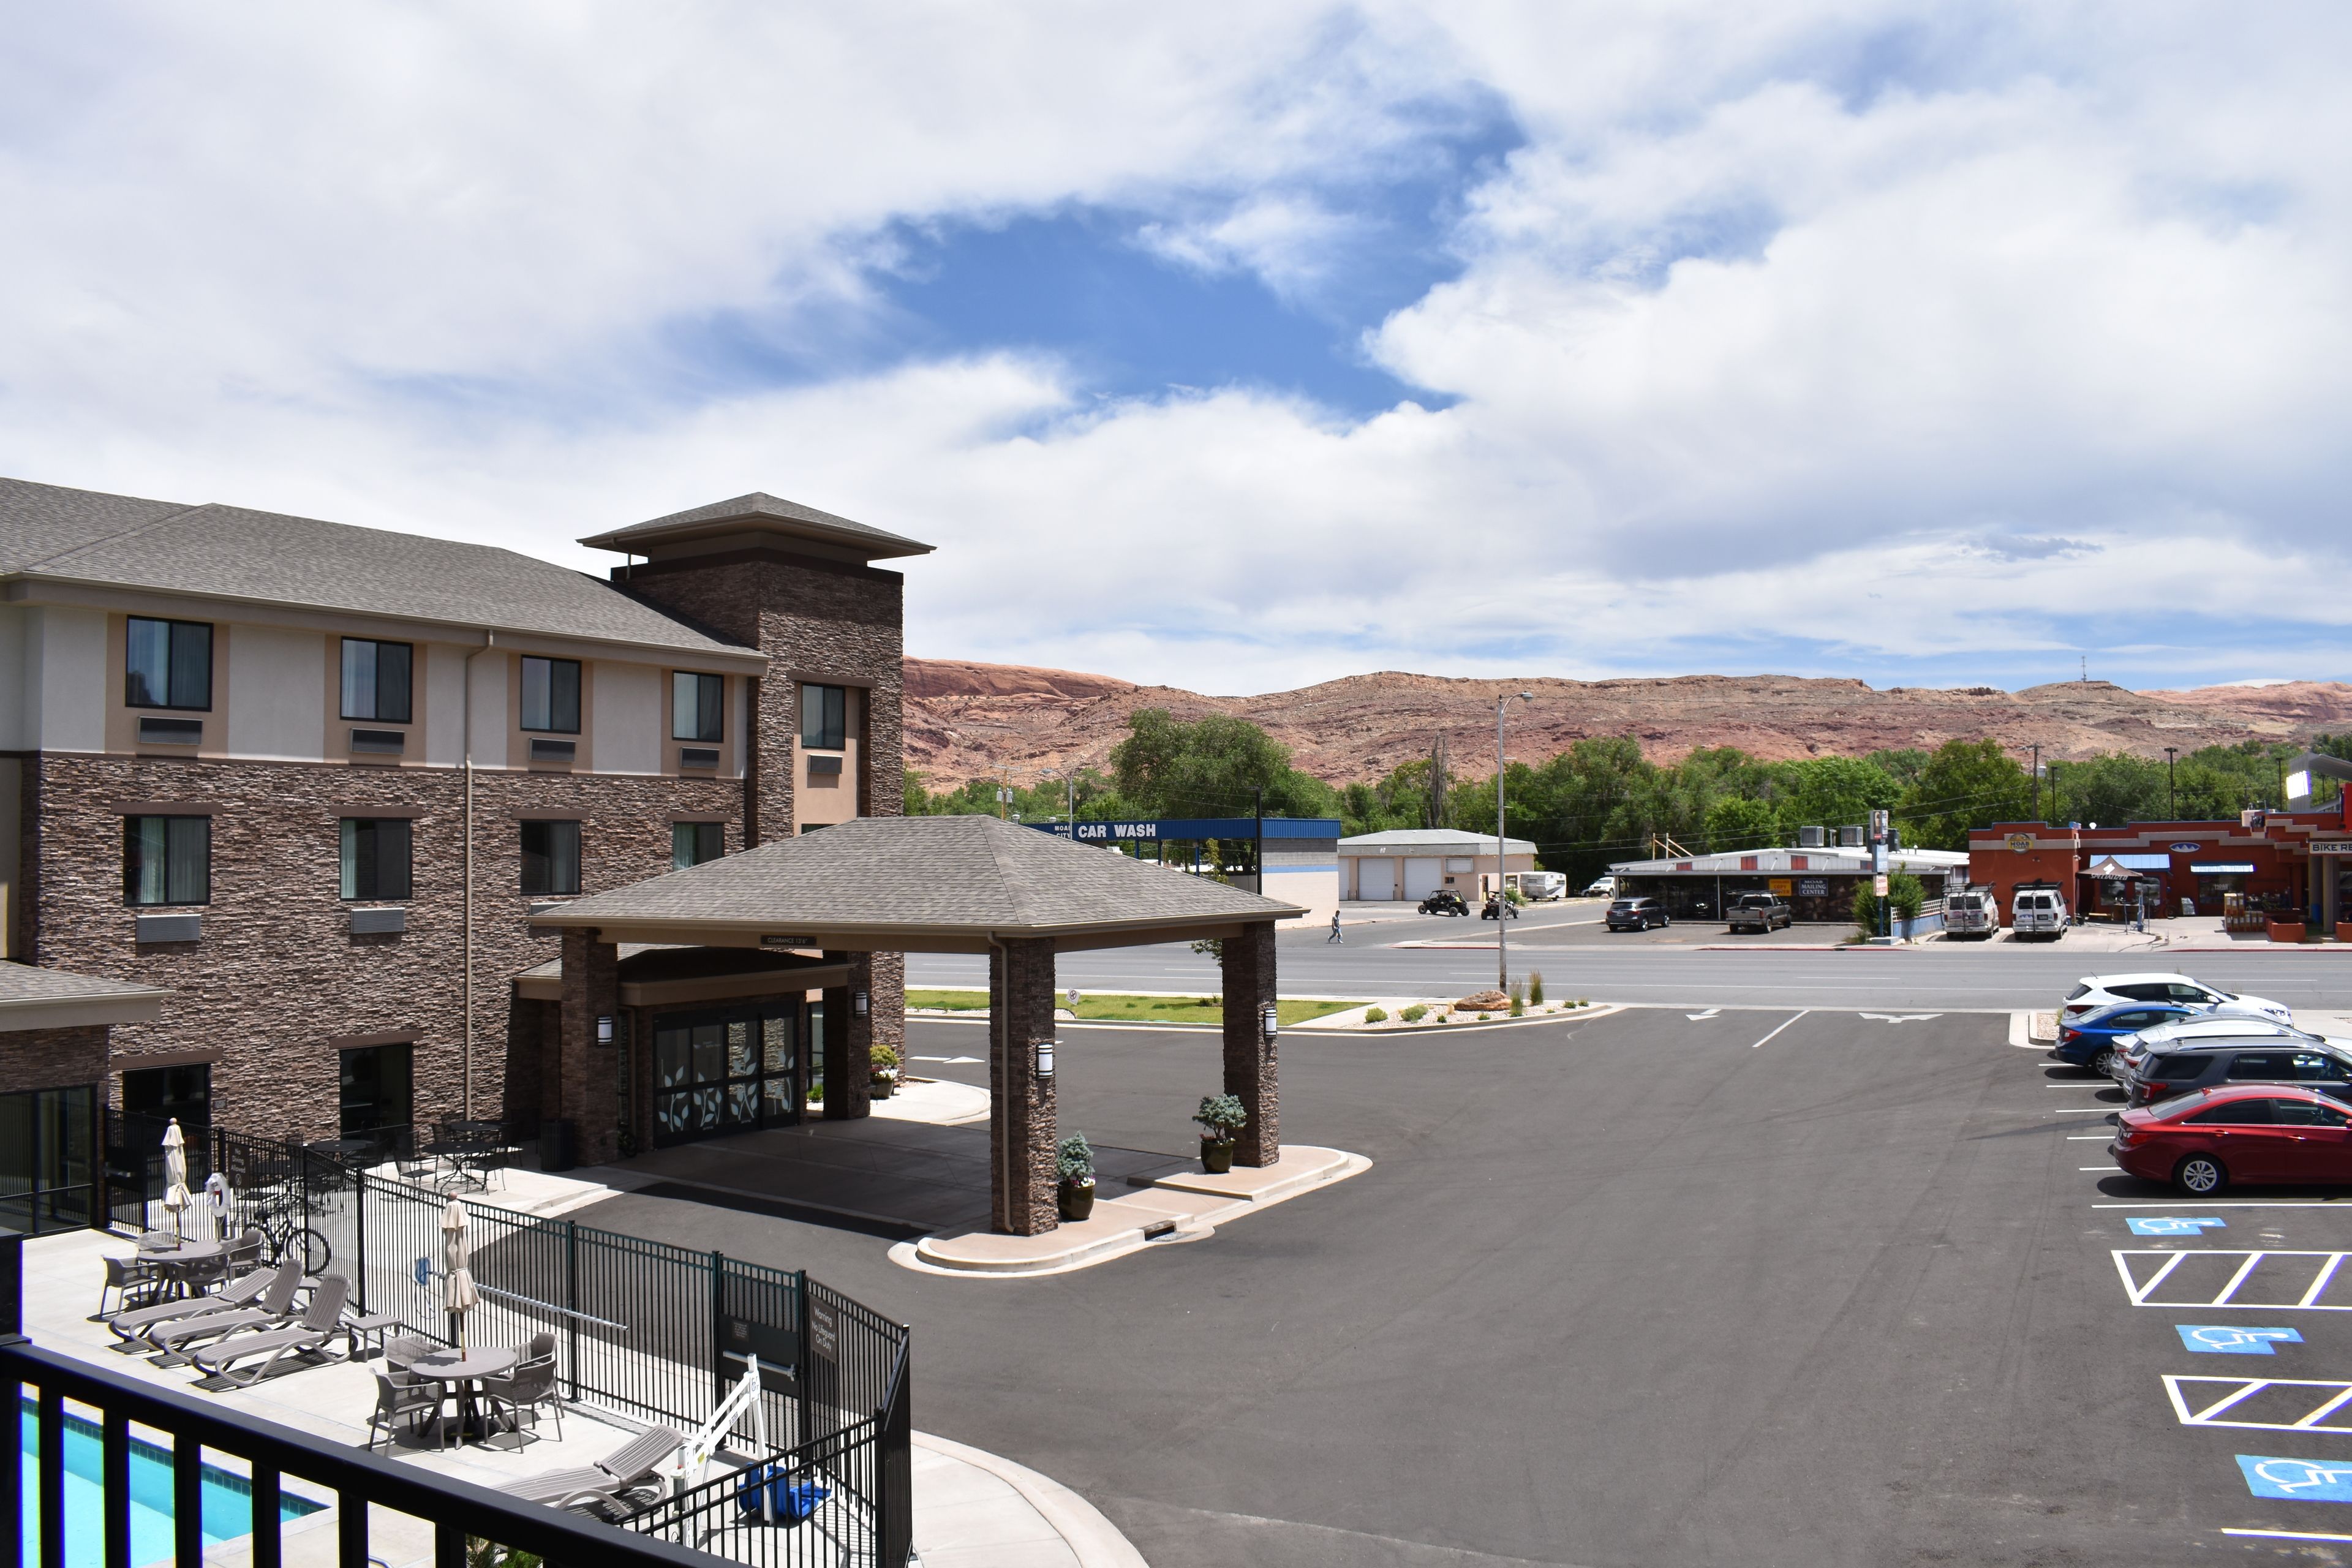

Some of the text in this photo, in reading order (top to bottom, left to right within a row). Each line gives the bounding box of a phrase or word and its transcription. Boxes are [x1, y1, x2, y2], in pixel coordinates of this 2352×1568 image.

[1078, 824, 1156, 838] CAR WASH
[231, 1164, 246, 1174] Allowed
[814, 1306, 832, 1328] Warning
[812, 1320, 835, 1342] No Lifeguard
[815, 1334, 832, 1353] On Duty
